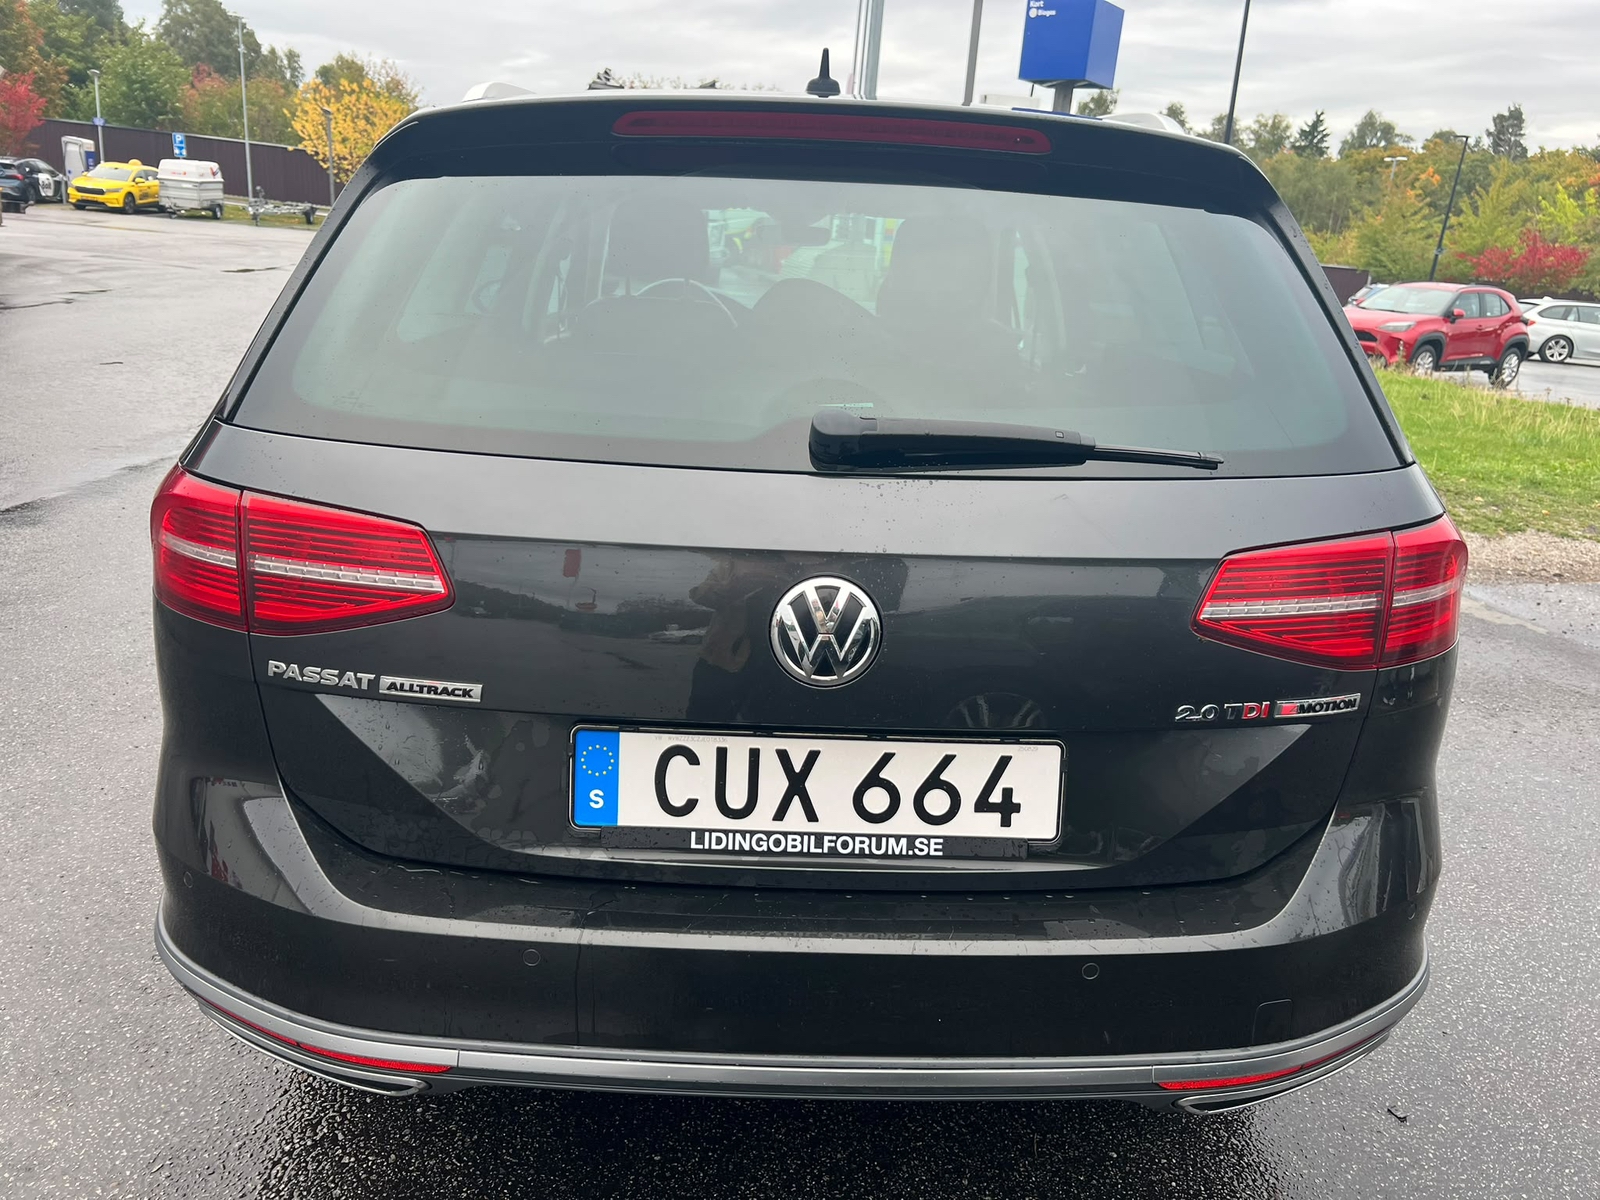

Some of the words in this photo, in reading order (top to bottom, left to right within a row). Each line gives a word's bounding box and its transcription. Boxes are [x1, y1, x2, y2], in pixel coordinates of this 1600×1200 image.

[175, 134, 182, 144] P
[770, 576, 880, 686] VW
[267, 660, 375, 690] PASSAT
[386, 681, 474, 698] ALLTRACK
[1175, 704, 1219, 721] 2.0
[1224, 701, 1270, 720] TDI
[654, 744, 821, 822] CUX
[852, 752, 1021, 827] 664
[589, 789, 604, 809] S
[690, 831, 944, 856] LIDINGOBILFORUM.SE
